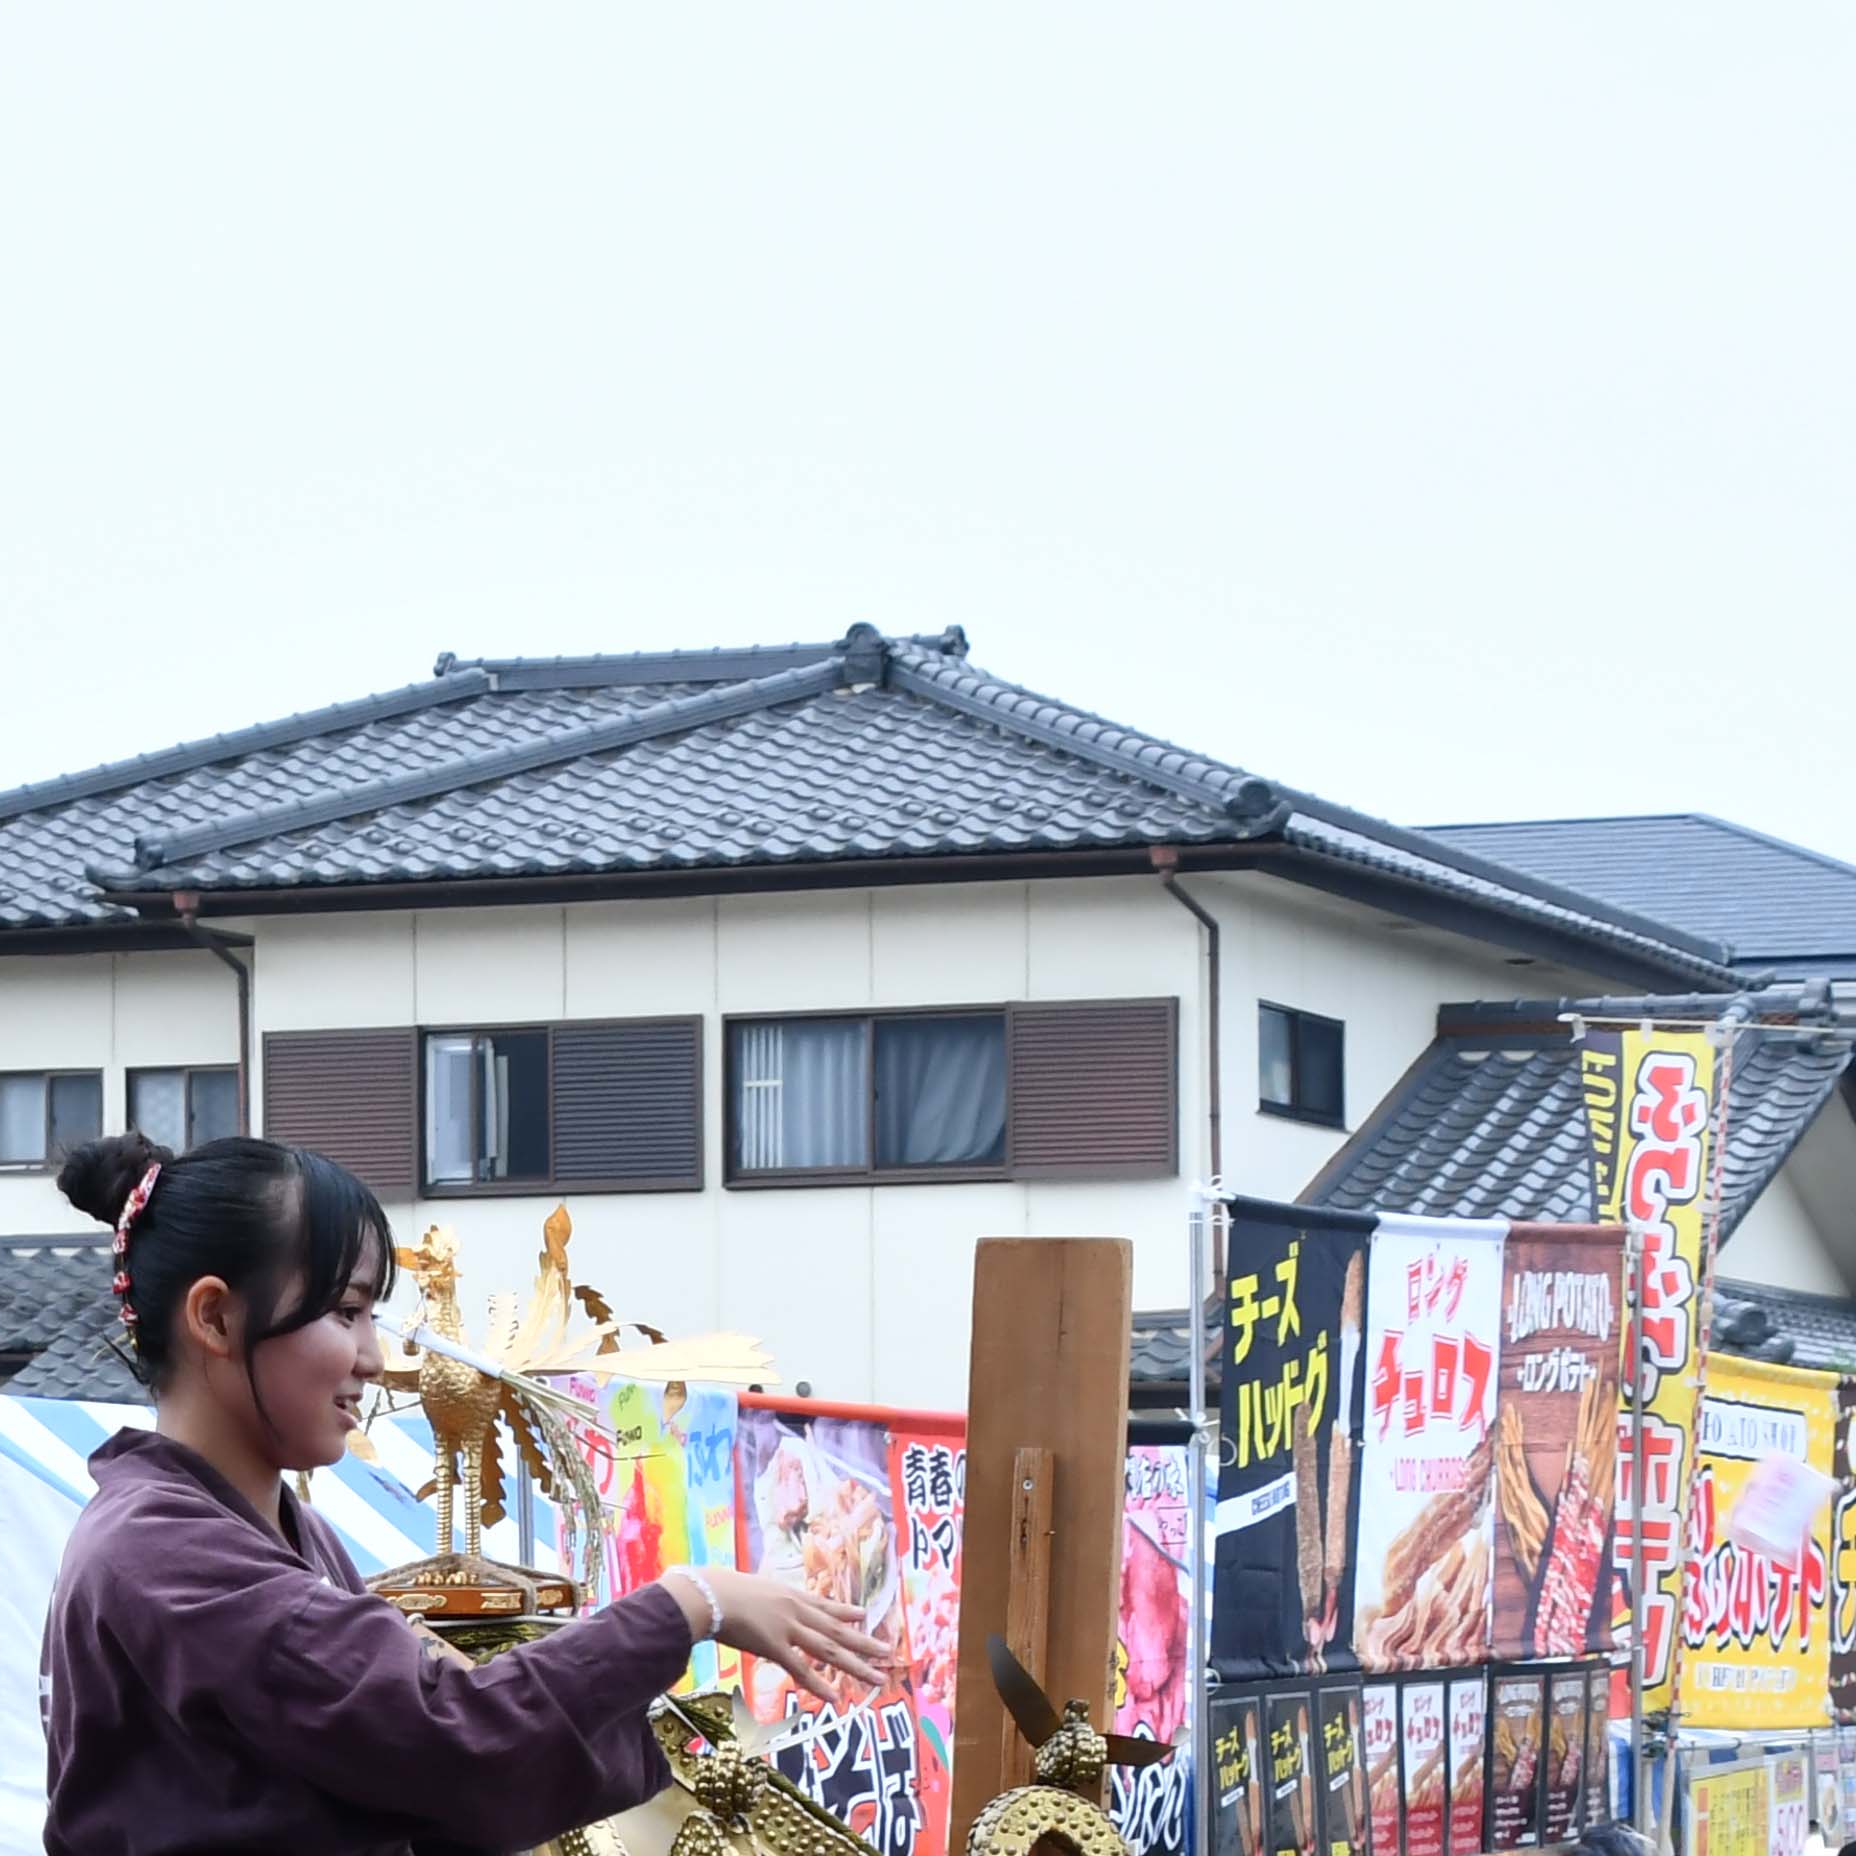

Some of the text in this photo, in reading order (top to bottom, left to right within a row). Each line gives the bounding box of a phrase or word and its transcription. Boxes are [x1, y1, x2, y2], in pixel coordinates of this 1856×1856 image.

[1231, 1241, 1301, 1365] チーズ
[1407, 1254, 1468, 1324] ロング
[1372, 1329, 1495, 1442] チュロス
